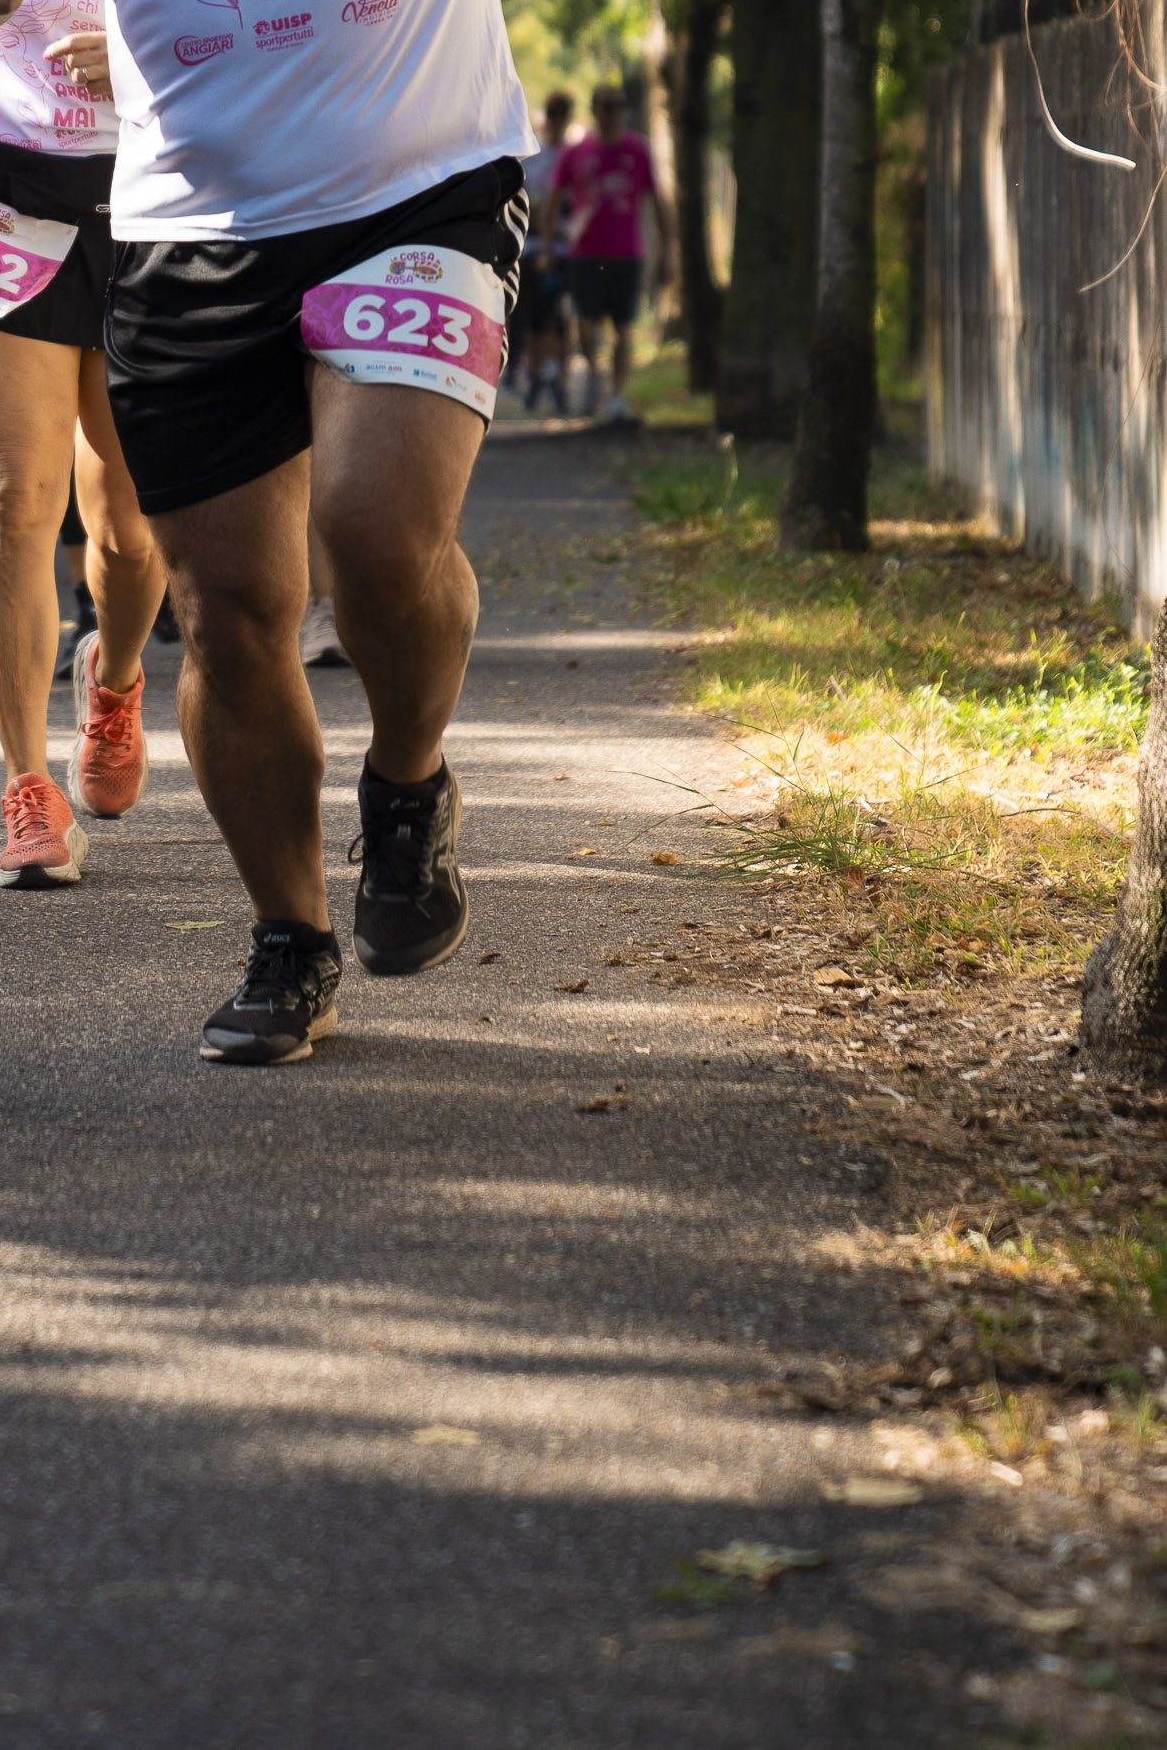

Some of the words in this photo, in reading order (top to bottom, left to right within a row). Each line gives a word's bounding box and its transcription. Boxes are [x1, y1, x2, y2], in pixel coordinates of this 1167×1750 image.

[70, 19, 107, 31] sem
[271, 12, 312, 32] UISP
[182, 38, 234, 58] ANGIARI
[255, 26, 314, 50] sportpertutti
[53, 108, 96, 128] MAI
[57, 131, 99, 149] sportpertutti
[400, 251, 436, 262] CORSA
[385, 274, 415, 285] ROSA
[343, 293, 473, 357] 623
